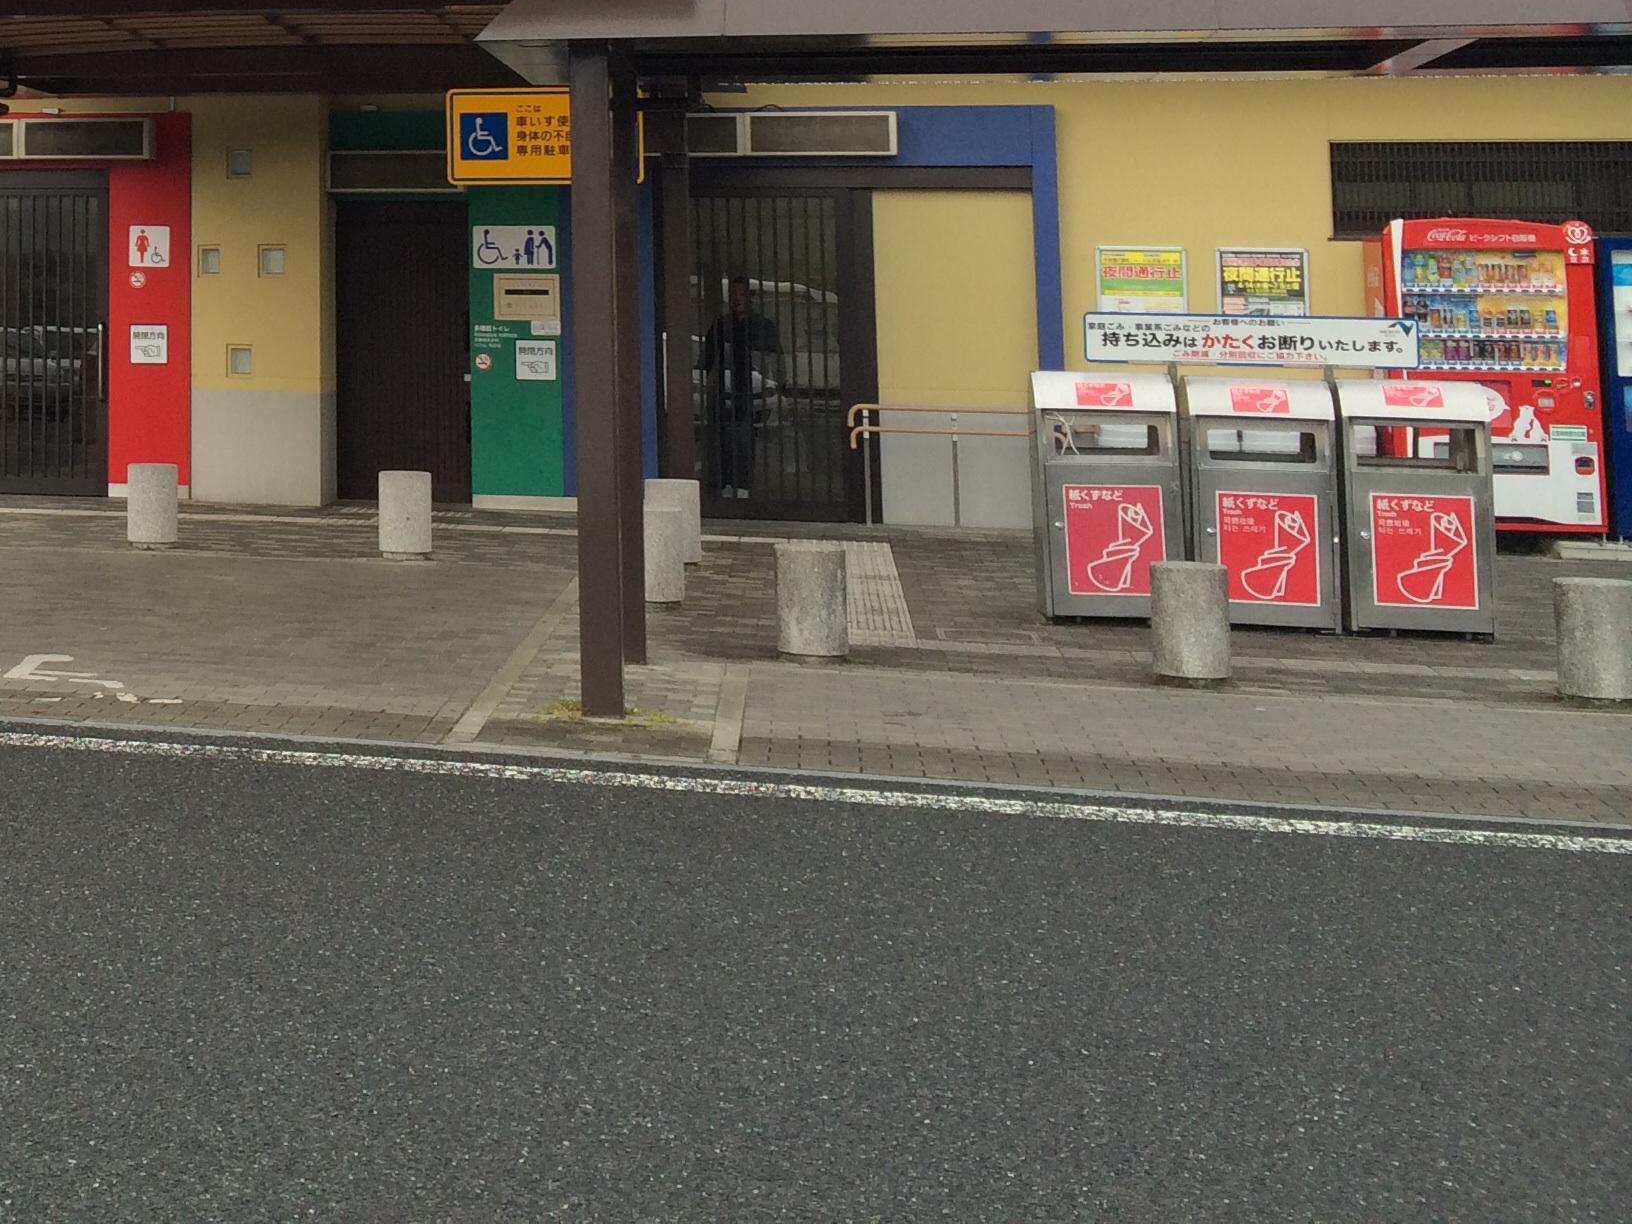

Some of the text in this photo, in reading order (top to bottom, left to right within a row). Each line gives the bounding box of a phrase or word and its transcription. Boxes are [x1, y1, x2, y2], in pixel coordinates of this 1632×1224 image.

[515, 104, 541, 113] ここは
[1102, 265, 1181, 280] 夜間通行止
[1222, 265, 1302, 283] 夜間通行止
[1068, 489, 1123, 501] 紙くずなど
[1069, 502, 1093, 510] Trash
[1222, 496, 1280, 510] 紙くずなど
[1376, 498, 1435, 512] 紙くずなど
